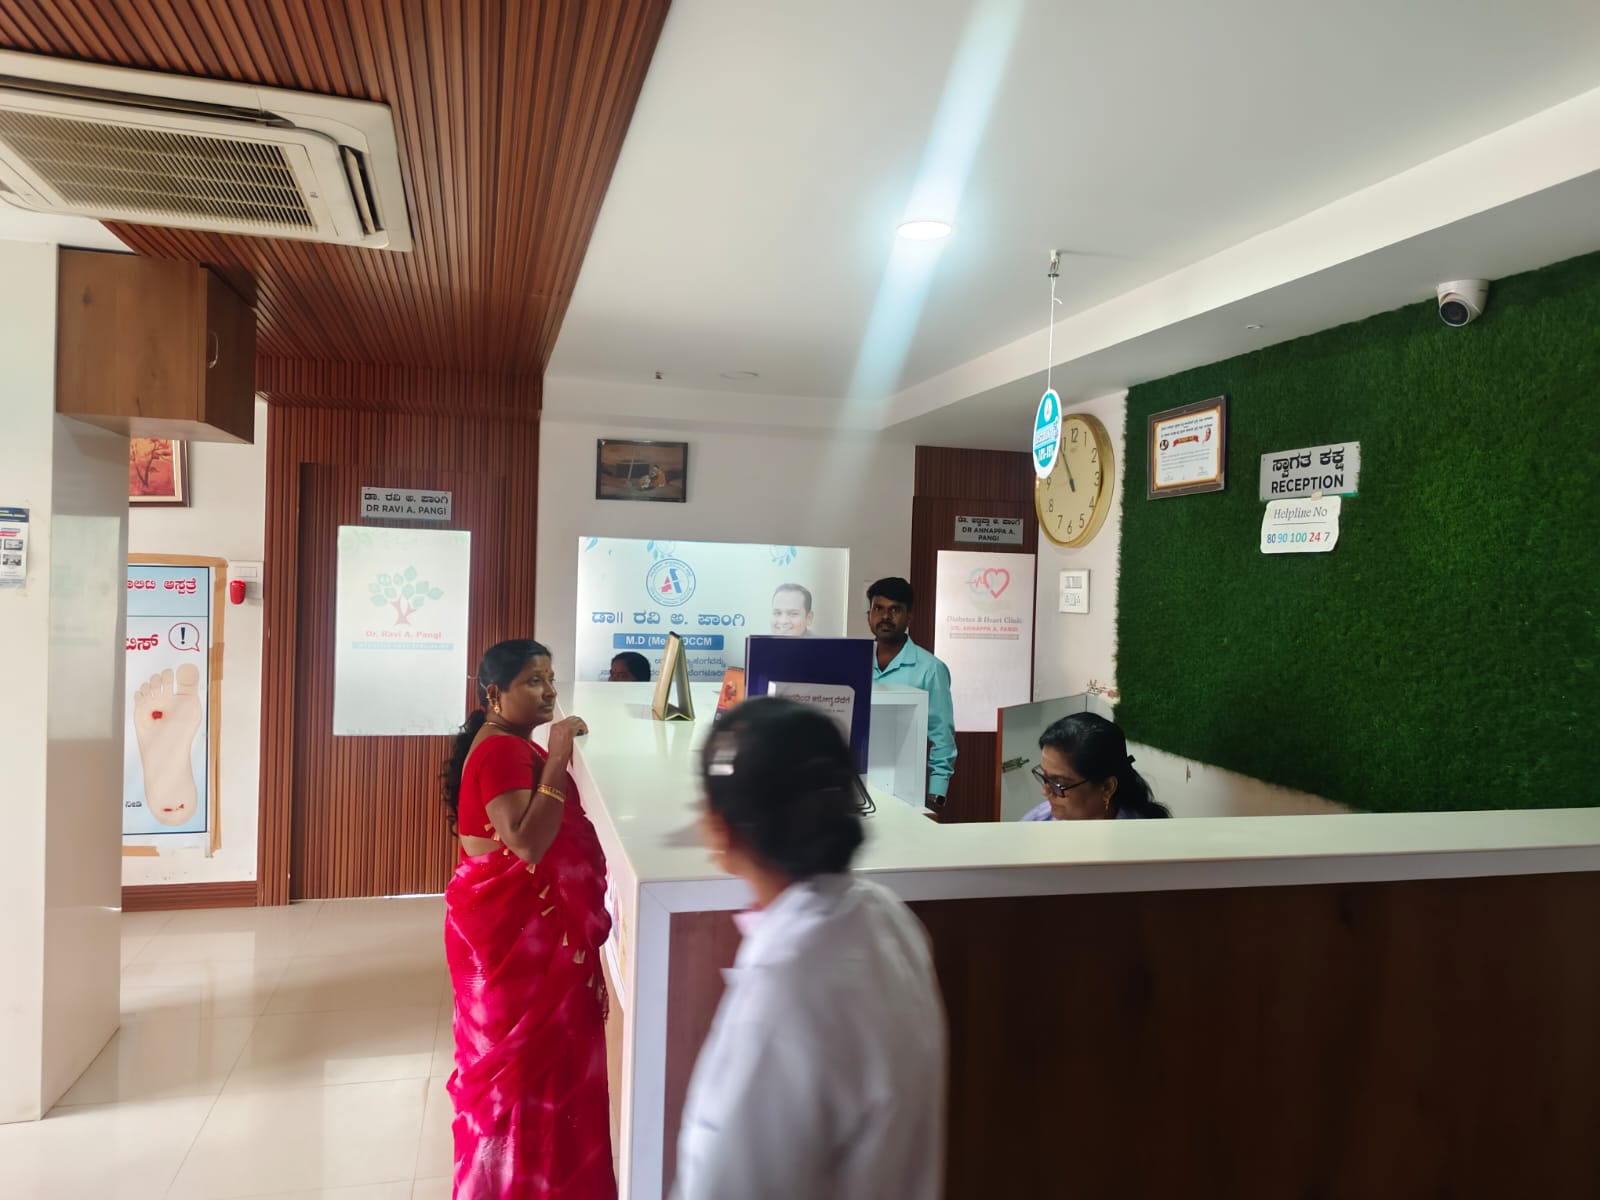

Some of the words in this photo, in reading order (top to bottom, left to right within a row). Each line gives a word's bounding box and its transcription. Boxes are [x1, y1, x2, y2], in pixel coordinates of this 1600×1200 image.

[1071, 428, 1078, 443] 12
[1091, 448, 1097, 463] 2
[1272, 451, 1312, 478] ಸ್ವಾಗತ
[1319, 446, 1345, 471] ಕಕ್ಷ
[1046, 477, 1051, 490] 9
[1094, 471, 1100, 486] 3
[1271, 474, 1344, 494] RECEPTION
[366, 504, 379, 512] DR
[382, 504, 404, 513] RAVI
[406, 506, 416, 514] A.
[418, 507, 447, 516] PANGI
[1048, 499, 1053, 512] 8
[1089, 496, 1095, 510] 4
[1079, 513, 1085, 528] 5
[1273, 507, 1312, 521] Helpline
[1313, 506, 1328, 518] No
[1058, 515, 1063, 529] 7
[1067, 520, 1072, 534] 6
[974, 527, 1006, 535] ANNAPPA
[1277, 533, 1288, 543] 90
[1290, 532, 1307, 543] 100
[1309, 531, 1321, 543] 24
[1324, 531, 1331, 542] 7
[633, 610, 661, 625] ರವಿ
[670, 612, 688, 625] ಅ.
[697, 612, 746, 627] ಪಾಂಗಿ
[626, 635, 645, 645] M.D
